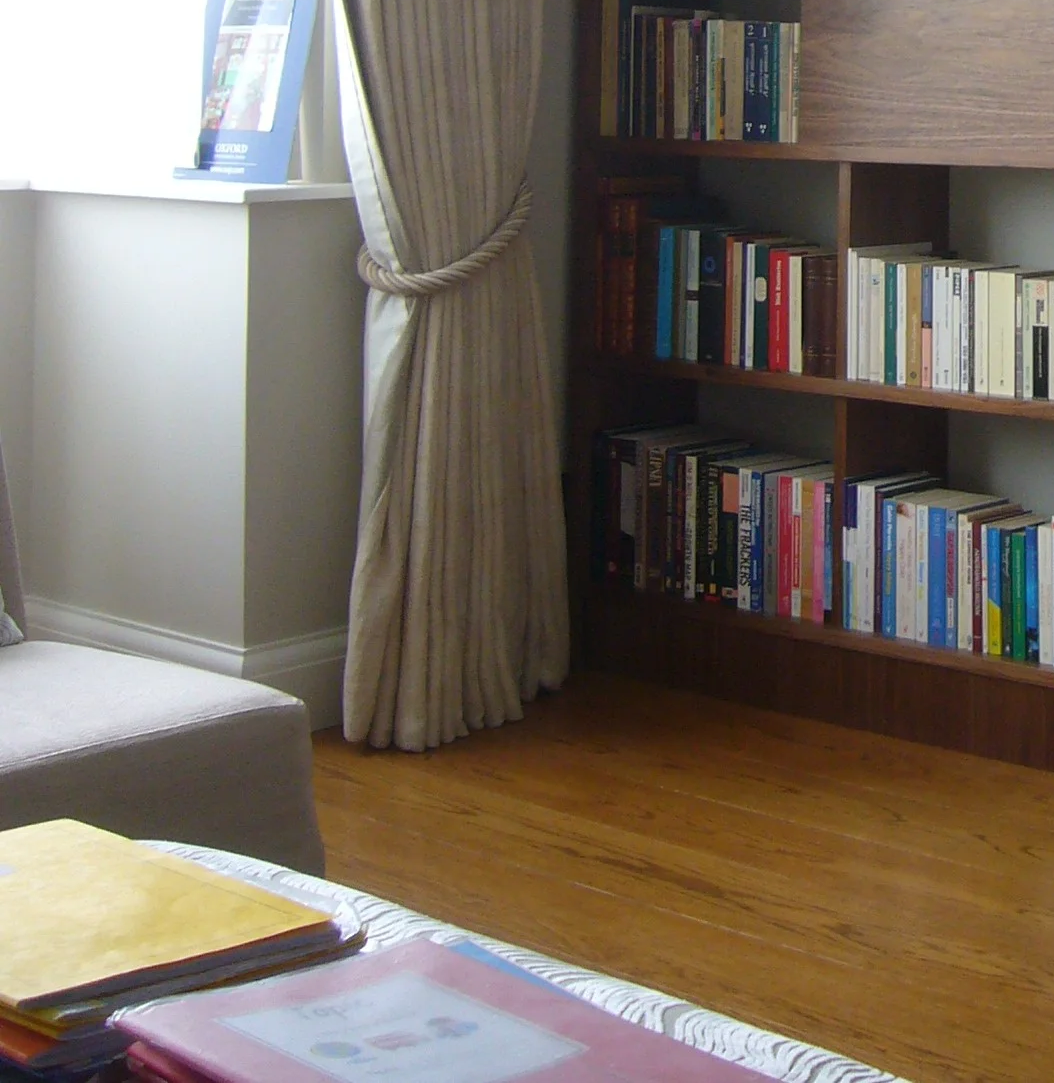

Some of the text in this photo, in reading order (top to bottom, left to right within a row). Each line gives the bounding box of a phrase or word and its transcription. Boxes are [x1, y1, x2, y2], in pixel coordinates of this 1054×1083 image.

[215, 142, 248, 154] OXFORD
[740, 505, 751, 525] THE
[739, 528, 751, 587] FRACKERS
